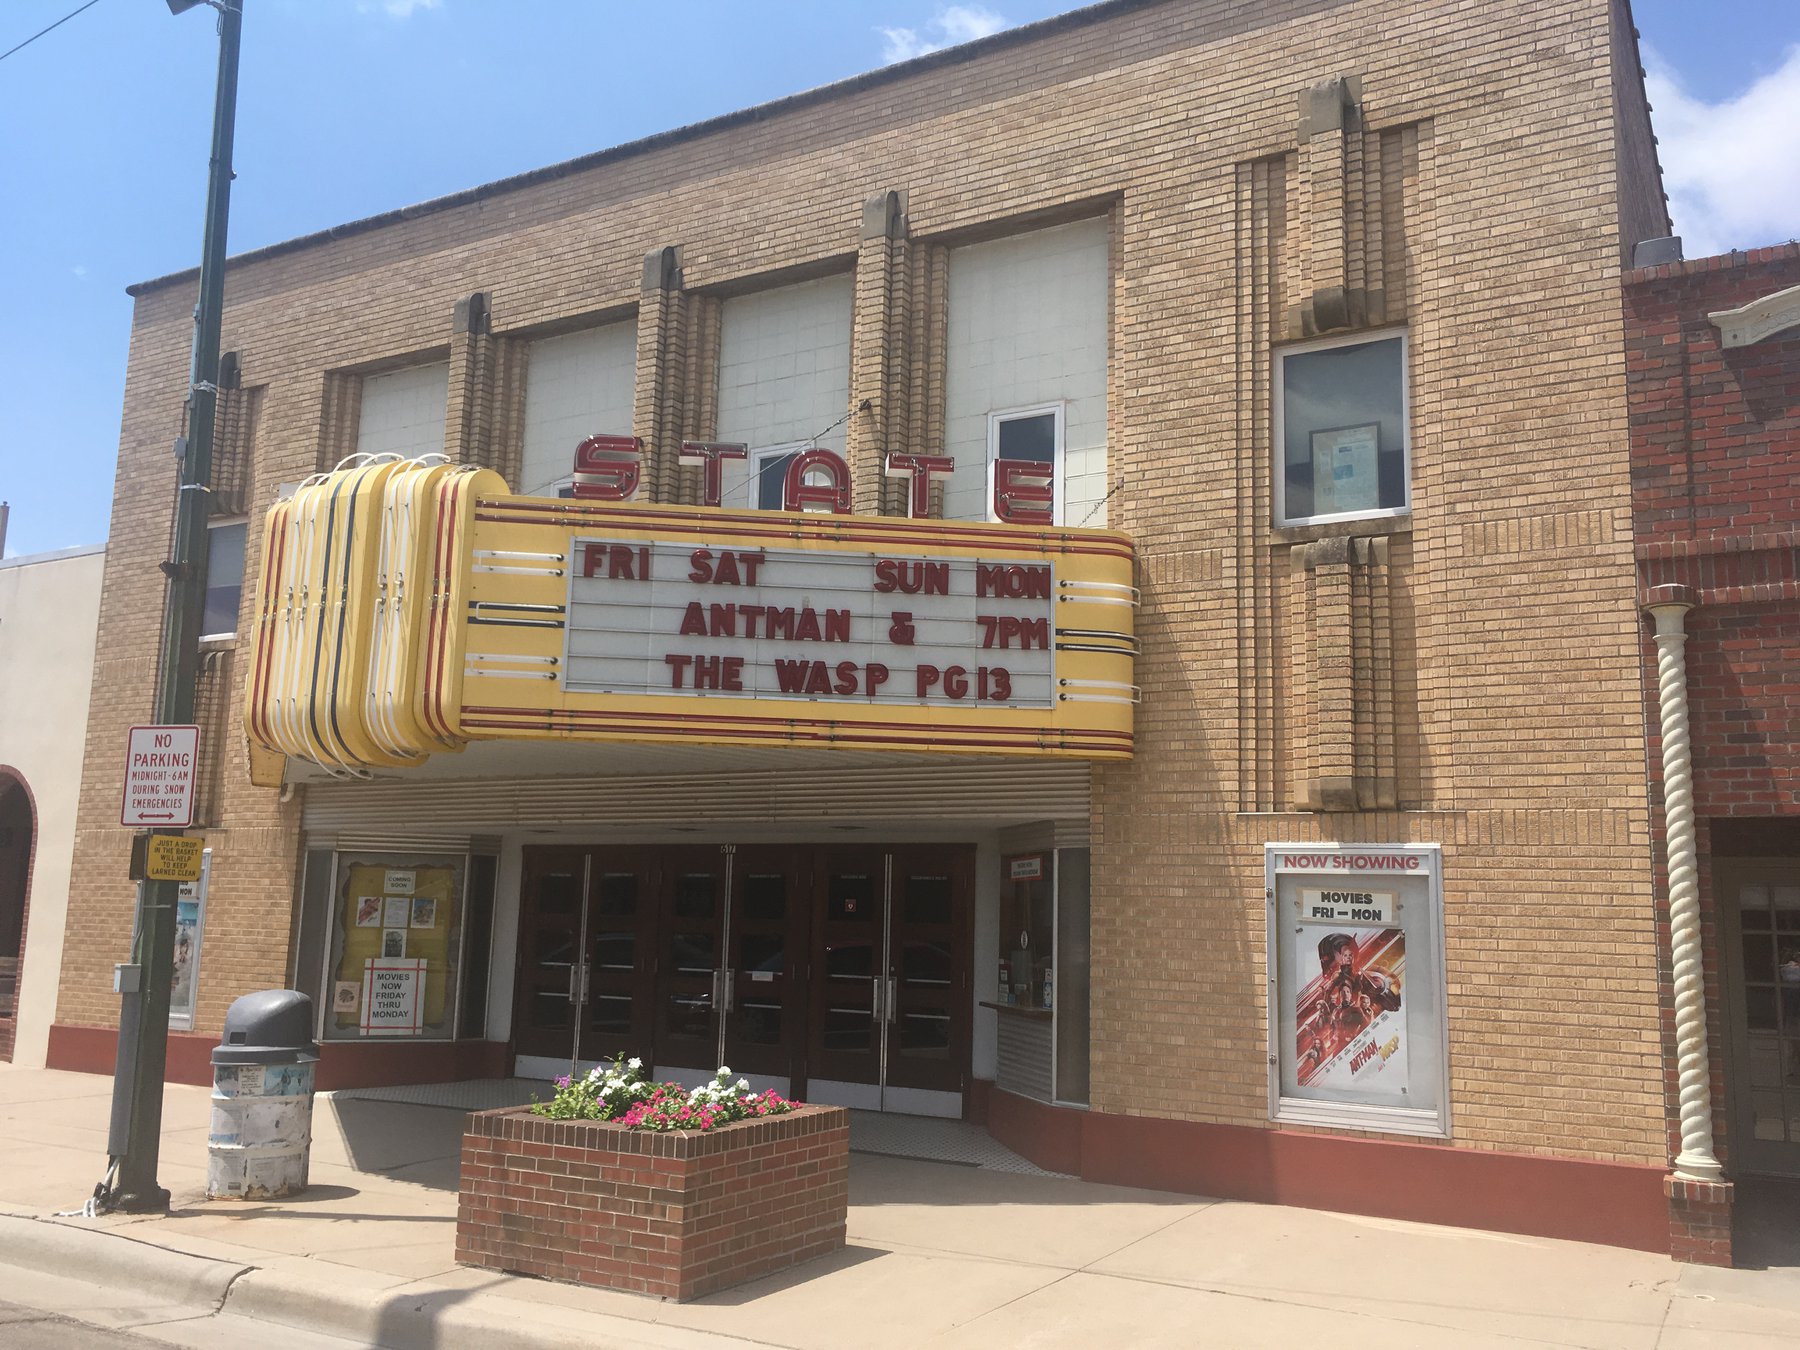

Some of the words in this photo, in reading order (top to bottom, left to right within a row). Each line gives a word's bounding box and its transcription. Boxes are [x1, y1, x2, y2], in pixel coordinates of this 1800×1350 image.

[572, 434, 1054, 525] STATE
[583, 543, 650, 580] FRI
[689, 550, 765, 586] SAT
[873, 559, 949, 596] SUN
[976, 565, 1050, 599] MON
[680, 602, 850, 643] ANTMAN
[890, 611, 915, 646] &
[977, 616, 1048, 650] 7PM
[665, 655, 744, 690] THE
[775, 659, 889, 697] WASP
[917, 664, 1012, 700] PG13
[154, 734, 172, 748] NO
[134, 753, 190, 767] PARKING
[132, 784, 160, 795] DURING
[164, 784, 185, 795] SNOW
[132, 798, 183, 809] EMERGENCIES
[157, 839, 173, 847] JUST
[721, 843, 736, 854] 617
[1284, 855, 1328, 868] NOW
[1332, 855, 1420, 870] SHOWING
[152, 867, 176, 875] LARNED
[1321, 891, 1373, 905] MOVIES
[1312, 906, 1334, 919] FRI
[1351, 909, 1382, 921] MON
[377, 973, 410, 981] MOVIES
[381, 982, 402, 990] NOW
[377, 1001, 401, 1009] THRU
[372, 1010, 408, 1018] MONDAY
